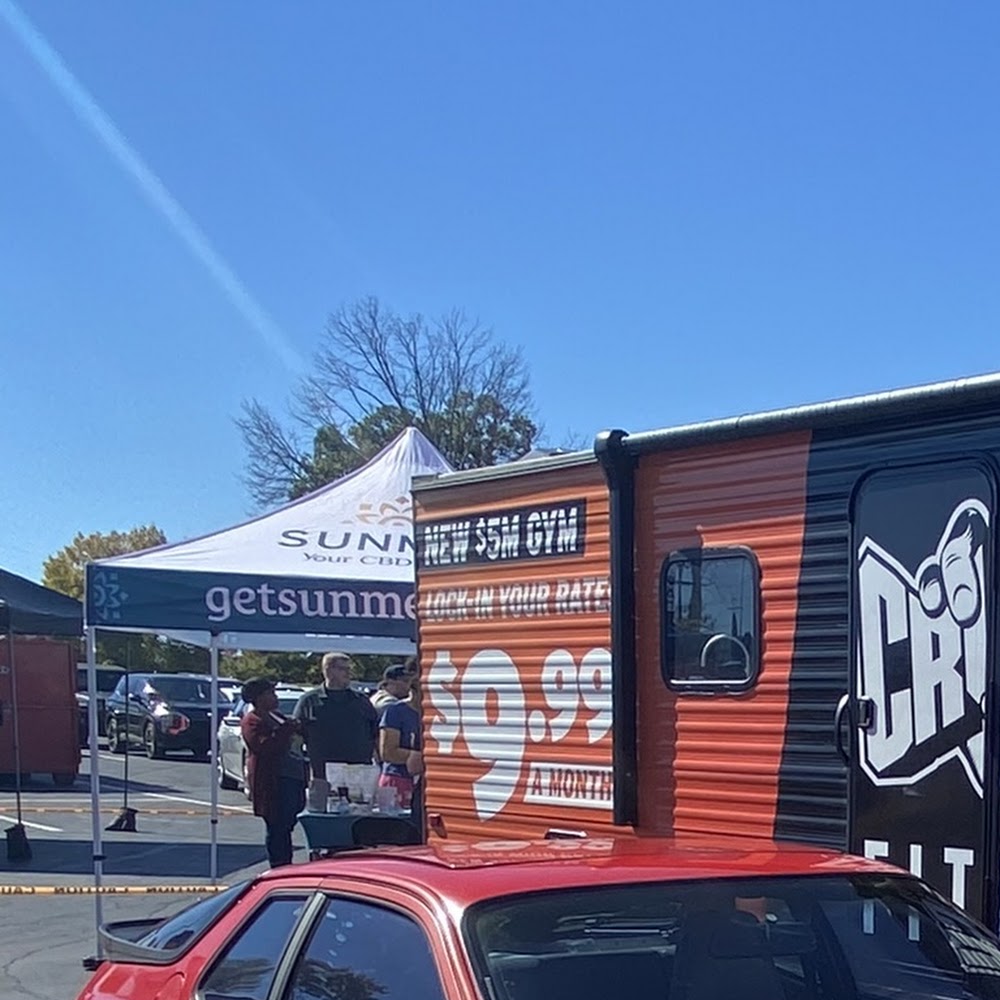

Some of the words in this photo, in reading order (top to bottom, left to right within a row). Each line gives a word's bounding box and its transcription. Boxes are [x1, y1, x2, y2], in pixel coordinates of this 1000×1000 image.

[424, 521, 471, 566] NEW
[475, 515, 520, 560] $5M
[526, 507, 578, 556] GYM
[359, 555, 412, 567] CBD
[425, 588, 494, 623] LOCK-IN
[500, 583, 549, 619] YOUR
[555, 575, 612, 616] RATE
[427, 648, 613, 823] $9.99
[531, 768, 543, 796] A
[549, 768, 613, 801] MONTH
